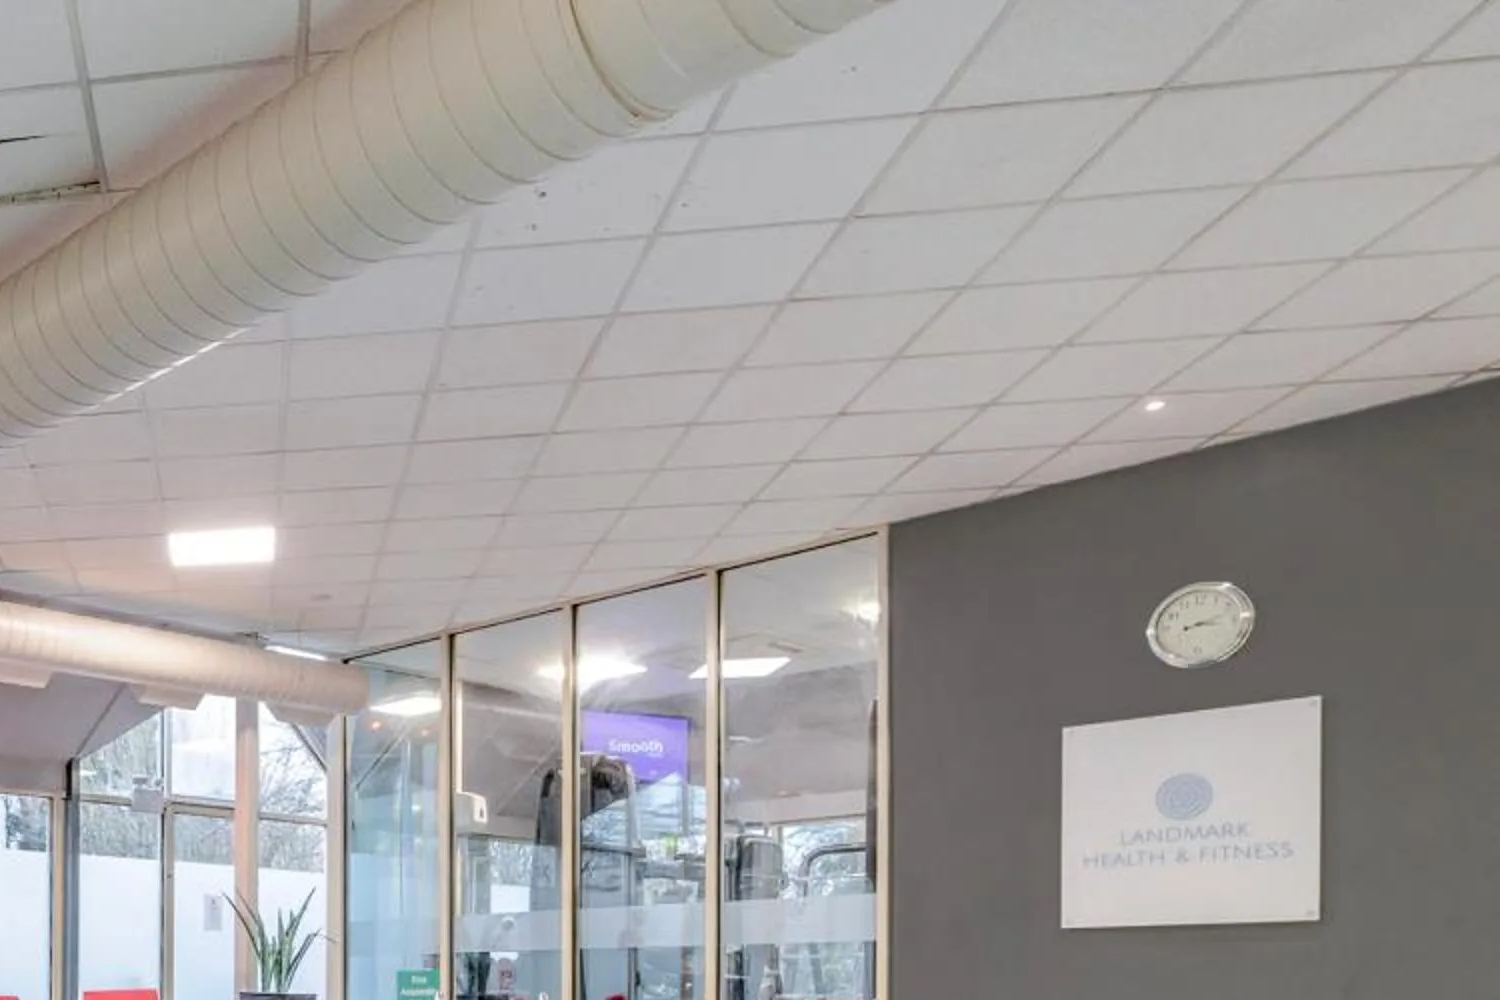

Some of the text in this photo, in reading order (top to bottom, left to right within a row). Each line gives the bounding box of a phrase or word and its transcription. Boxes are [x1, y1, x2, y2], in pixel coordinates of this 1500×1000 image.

[609, 739, 664, 753] Smooth
[1120, 822, 1250, 846] LANDMARK
[1082, 840, 1295, 869] HEALTH & FITNESS
